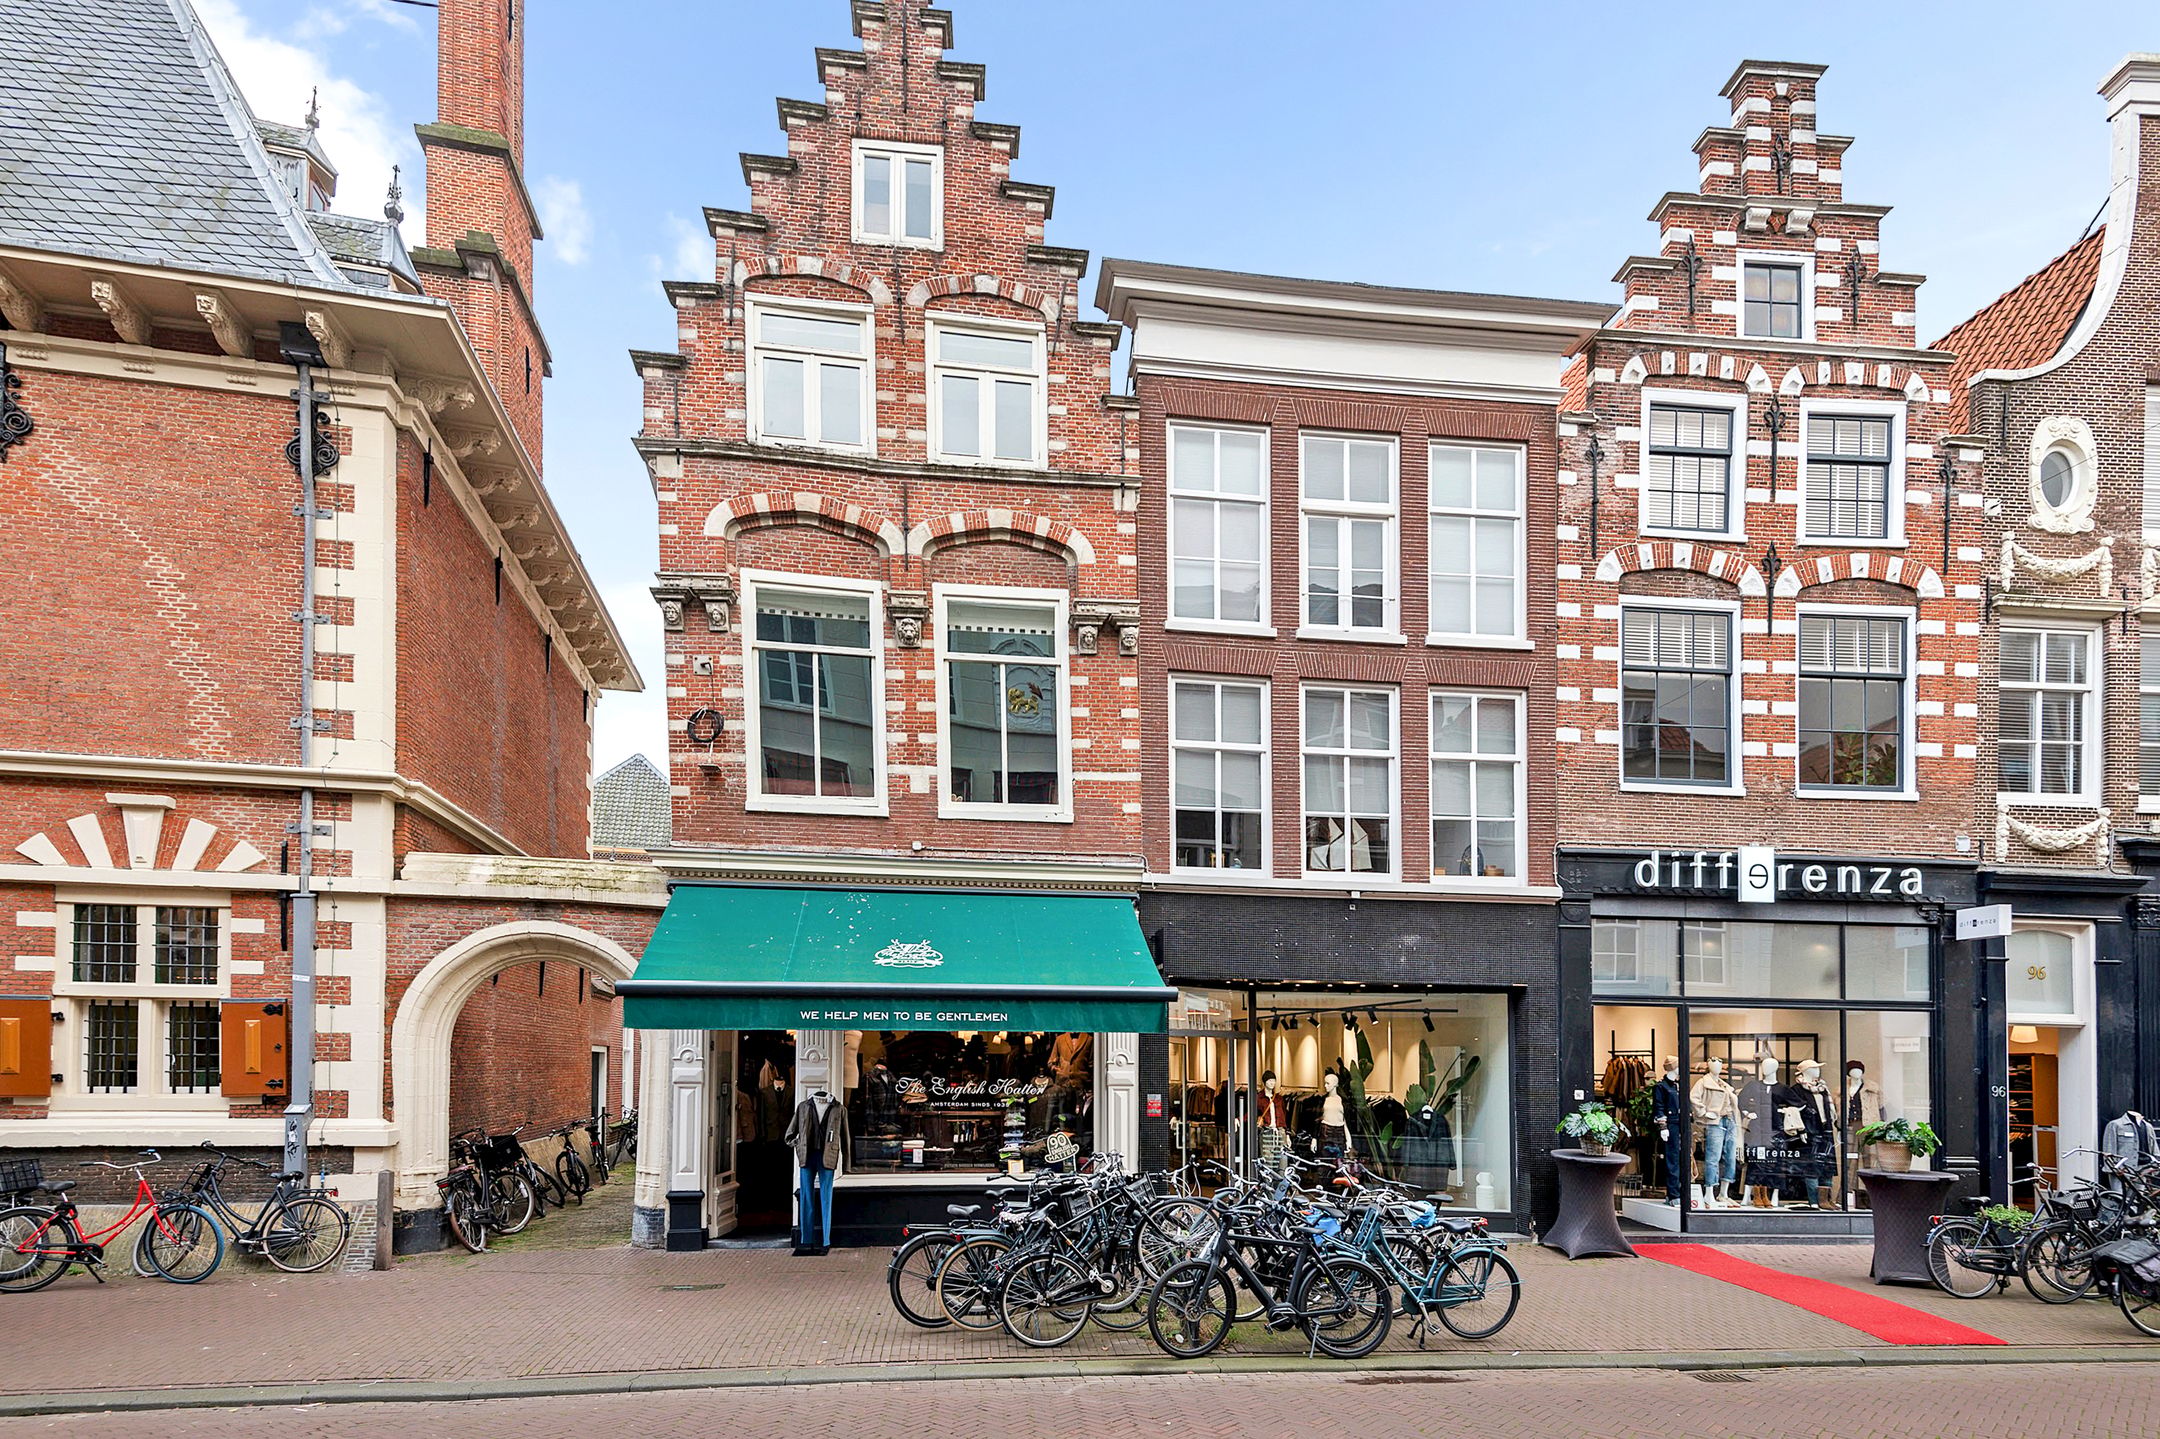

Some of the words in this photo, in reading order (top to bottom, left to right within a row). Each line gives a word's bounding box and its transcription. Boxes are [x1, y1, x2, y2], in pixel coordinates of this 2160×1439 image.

[1633, 849, 1924, 896] differenza
[2027, 965, 2047, 980] 96
[799, 1010, 820, 1020] WE
[824, 1011, 859, 1020] HELP
[863, 1011, 889, 1021] MEN
[893, 1011, 910, 1021] TO
[914, 1012, 932, 1021] BE
[936, 1012, 1008, 1022] GENTLEMEN
[895, 1076, 926, 1094] The
[928, 1076, 986, 1100] English
[988, 1078, 1046, 1096] Hatter
[1991, 1085, 2006, 1098] 96
[1049, 1134, 1067, 1149] 90
[1048, 1147, 1077, 1162] HATTER
